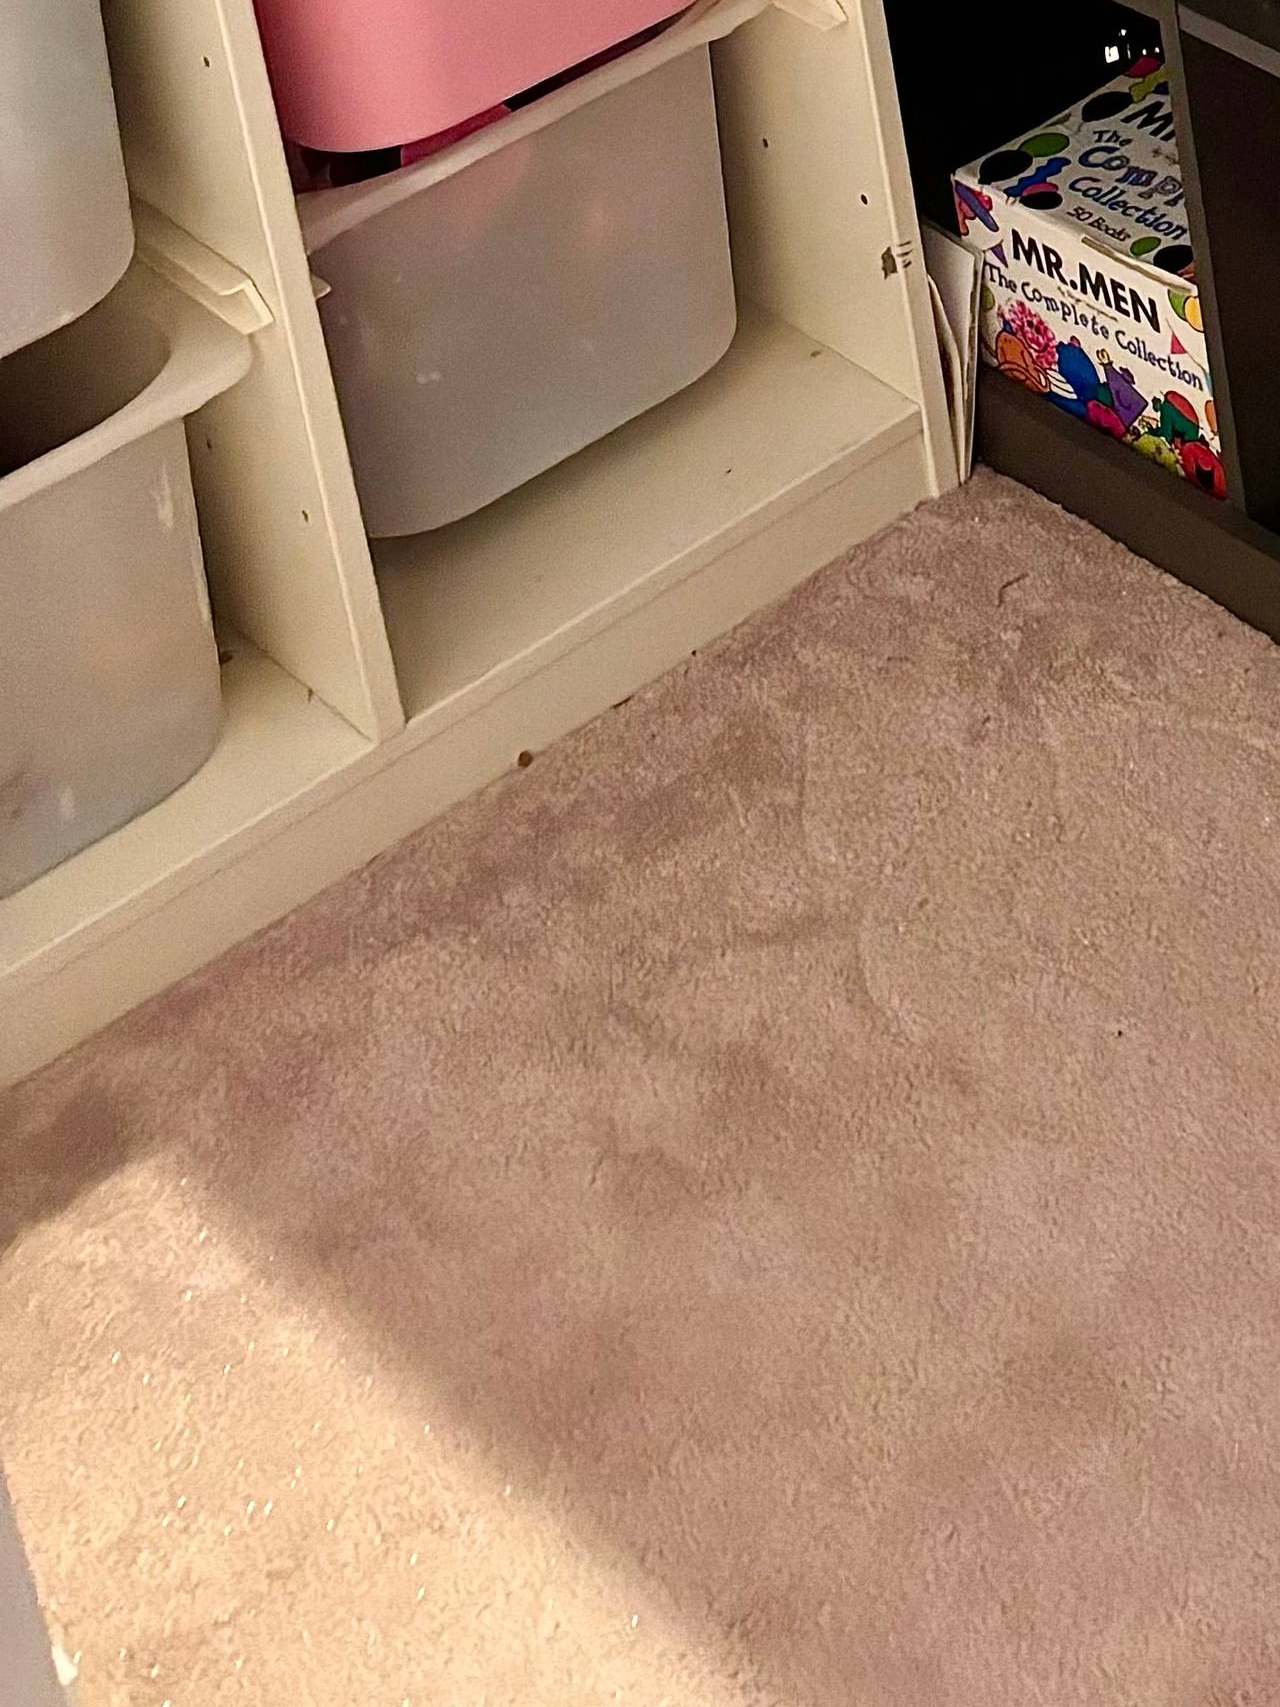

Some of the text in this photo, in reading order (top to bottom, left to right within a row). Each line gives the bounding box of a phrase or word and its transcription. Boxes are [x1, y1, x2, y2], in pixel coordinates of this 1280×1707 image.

[1093, 130, 1133, 147] The
[1067, 205, 1092, 222] 50
[1068, 176, 1187, 240] Collection
[985, 262, 1018, 293] The
[1021, 282, 1110, 339] Complete
[1115, 330, 1204, 393] Collection
